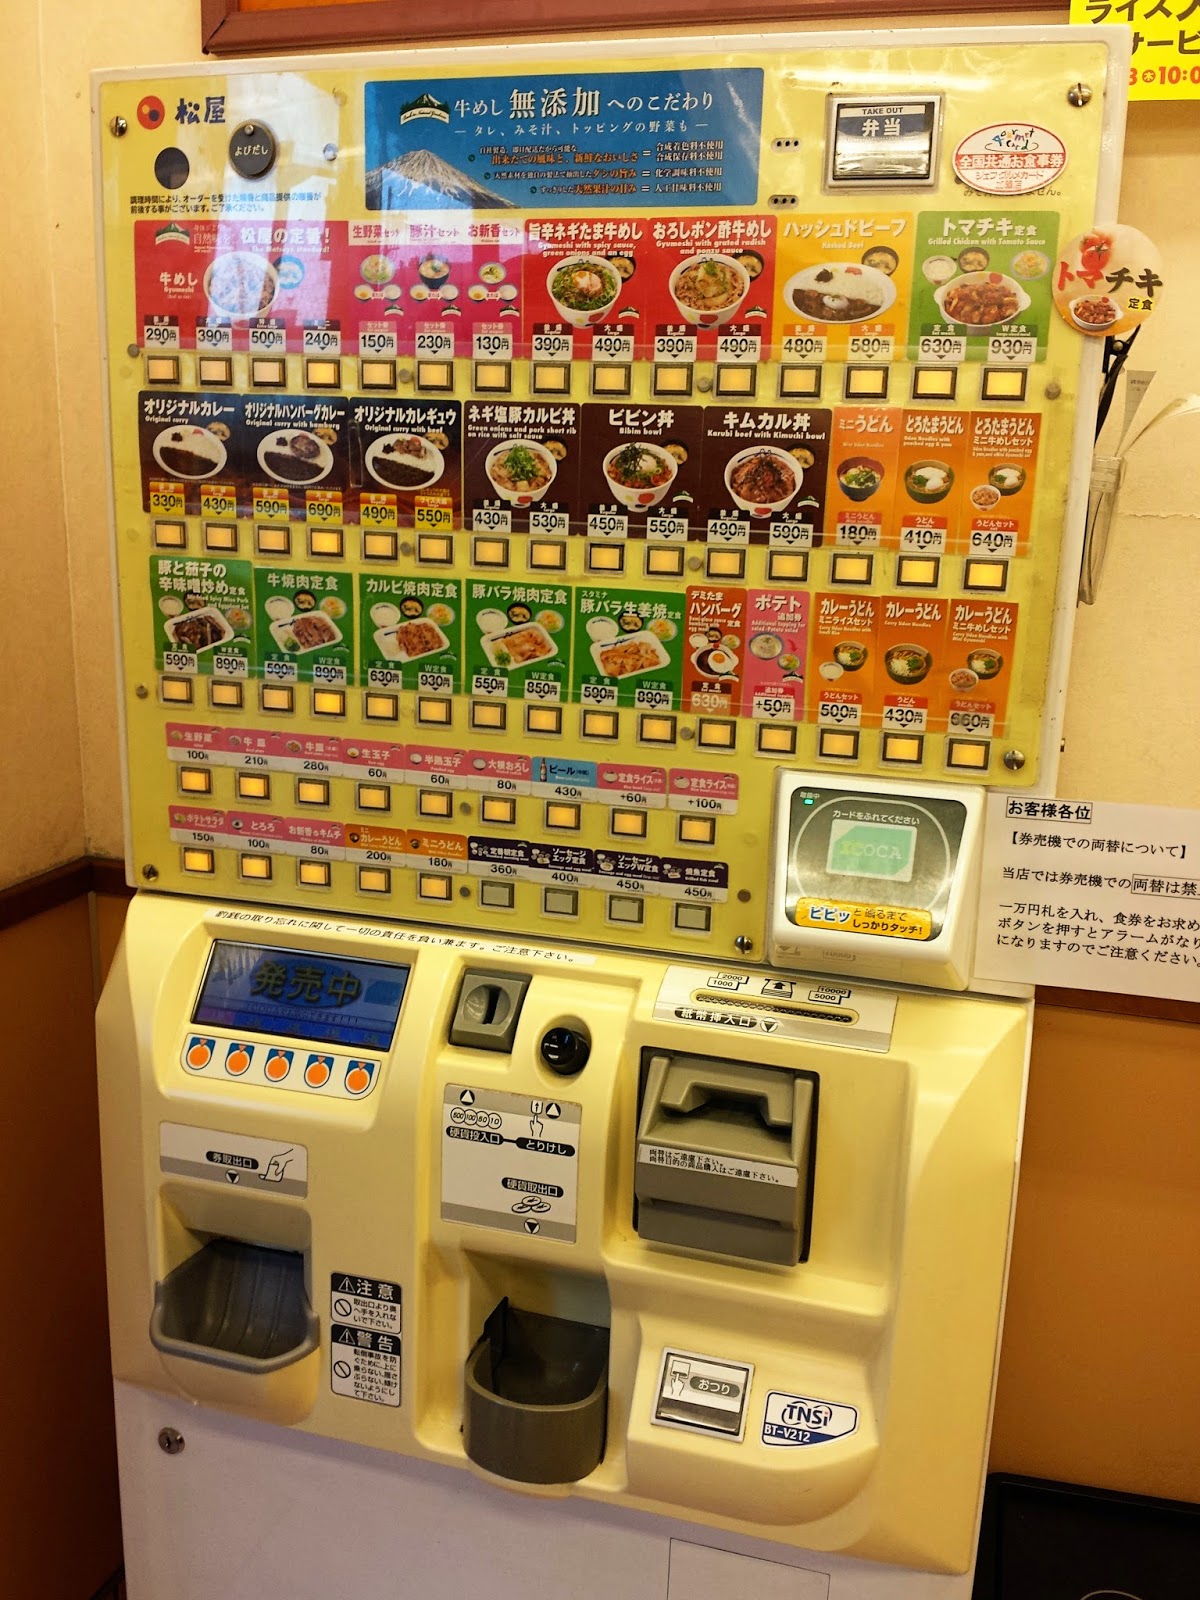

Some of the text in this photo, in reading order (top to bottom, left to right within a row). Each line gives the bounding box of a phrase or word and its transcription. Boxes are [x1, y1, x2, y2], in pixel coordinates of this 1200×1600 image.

[175, 96, 226, 124] 松屋
[862, 107, 883, 115] TAKE
[862, 118, 901, 137] 弁当
[234, 145, 268, 156] よびだし
[959, 154, 1064, 169] 全国共通お食事券
[528, 222, 643, 241] 旨辛ネギたま牛めし
[653, 219, 772, 240] おろしポン酢牛めし
[783, 219, 907, 238] ハッシュドビーフ
[159, 272, 198, 286] 牛めし
[1058, 261, 1163, 297] トマチキ
[1128, 298, 1153, 310] 定食
[143, 398, 235, 417] オリジナルカレー
[245, 402, 345, 421] オリジナルハンバーグカレー
[354, 405, 457, 426] オリジナルカレギュウ
[468, 405, 576, 426] ネギ塩豚カルビ丼
[609, 408, 674, 428] ビビン丼
[723, 411, 811, 432] キムカル丼
[839, 415, 894, 434] ミニうどん
[906, 416, 964, 435] とろたまうどん
[975, 417, 1035, 436] とろたまうどん
[915, 516, 934, 525] うどん
[267, 573, 339, 591] 牛焼肉定食
[366, 578, 458, 599] カルビ焼肉定食
[472, 584, 568, 605] 豚バラ焼肉定食
[582, 590, 608, 599] スタミナ
[691, 591, 724, 602] デミたま
[755, 594, 801, 612] ポテト
[690, 602, 742, 618] ハンバーグ
[820, 599, 875, 617] カレーうどん
[886, 601, 941, 621] カレーうどん
[955, 605, 1012, 624] カレーうどん
[832, 810, 920, 825] カードをふれてください
[1008, 800, 1091, 820] お客様各位
[1011, 831, 1187, 859] 【券売機での両替について】
[1003, 866, 1200, 897] 当店では券売機での両替は禁
[853, 919, 923, 935] しっかりタッチ!
[251, 960, 362, 1007] 発売中
[712, 979, 733, 987] 1000
[722, 973, 743, 981] 2000
[815, 992, 837, 1001] 5000
[820, 986, 847, 995] 10000
[680, 1008, 751, 1026] 紙幣挿入口
[490, 1117, 499, 1125] 10
[449, 1127, 500, 1144] 硬貨投入口
[525, 1139, 567, 1155] とりけし
[213, 1153, 252, 1168] 券取出口
[506, 1179, 558, 1196] 硬貨取出口
[356, 1278, 394, 1301] 注意
[698, 1378, 731, 1395] おつり
[764, 1423, 810, 1442] BT-V212
